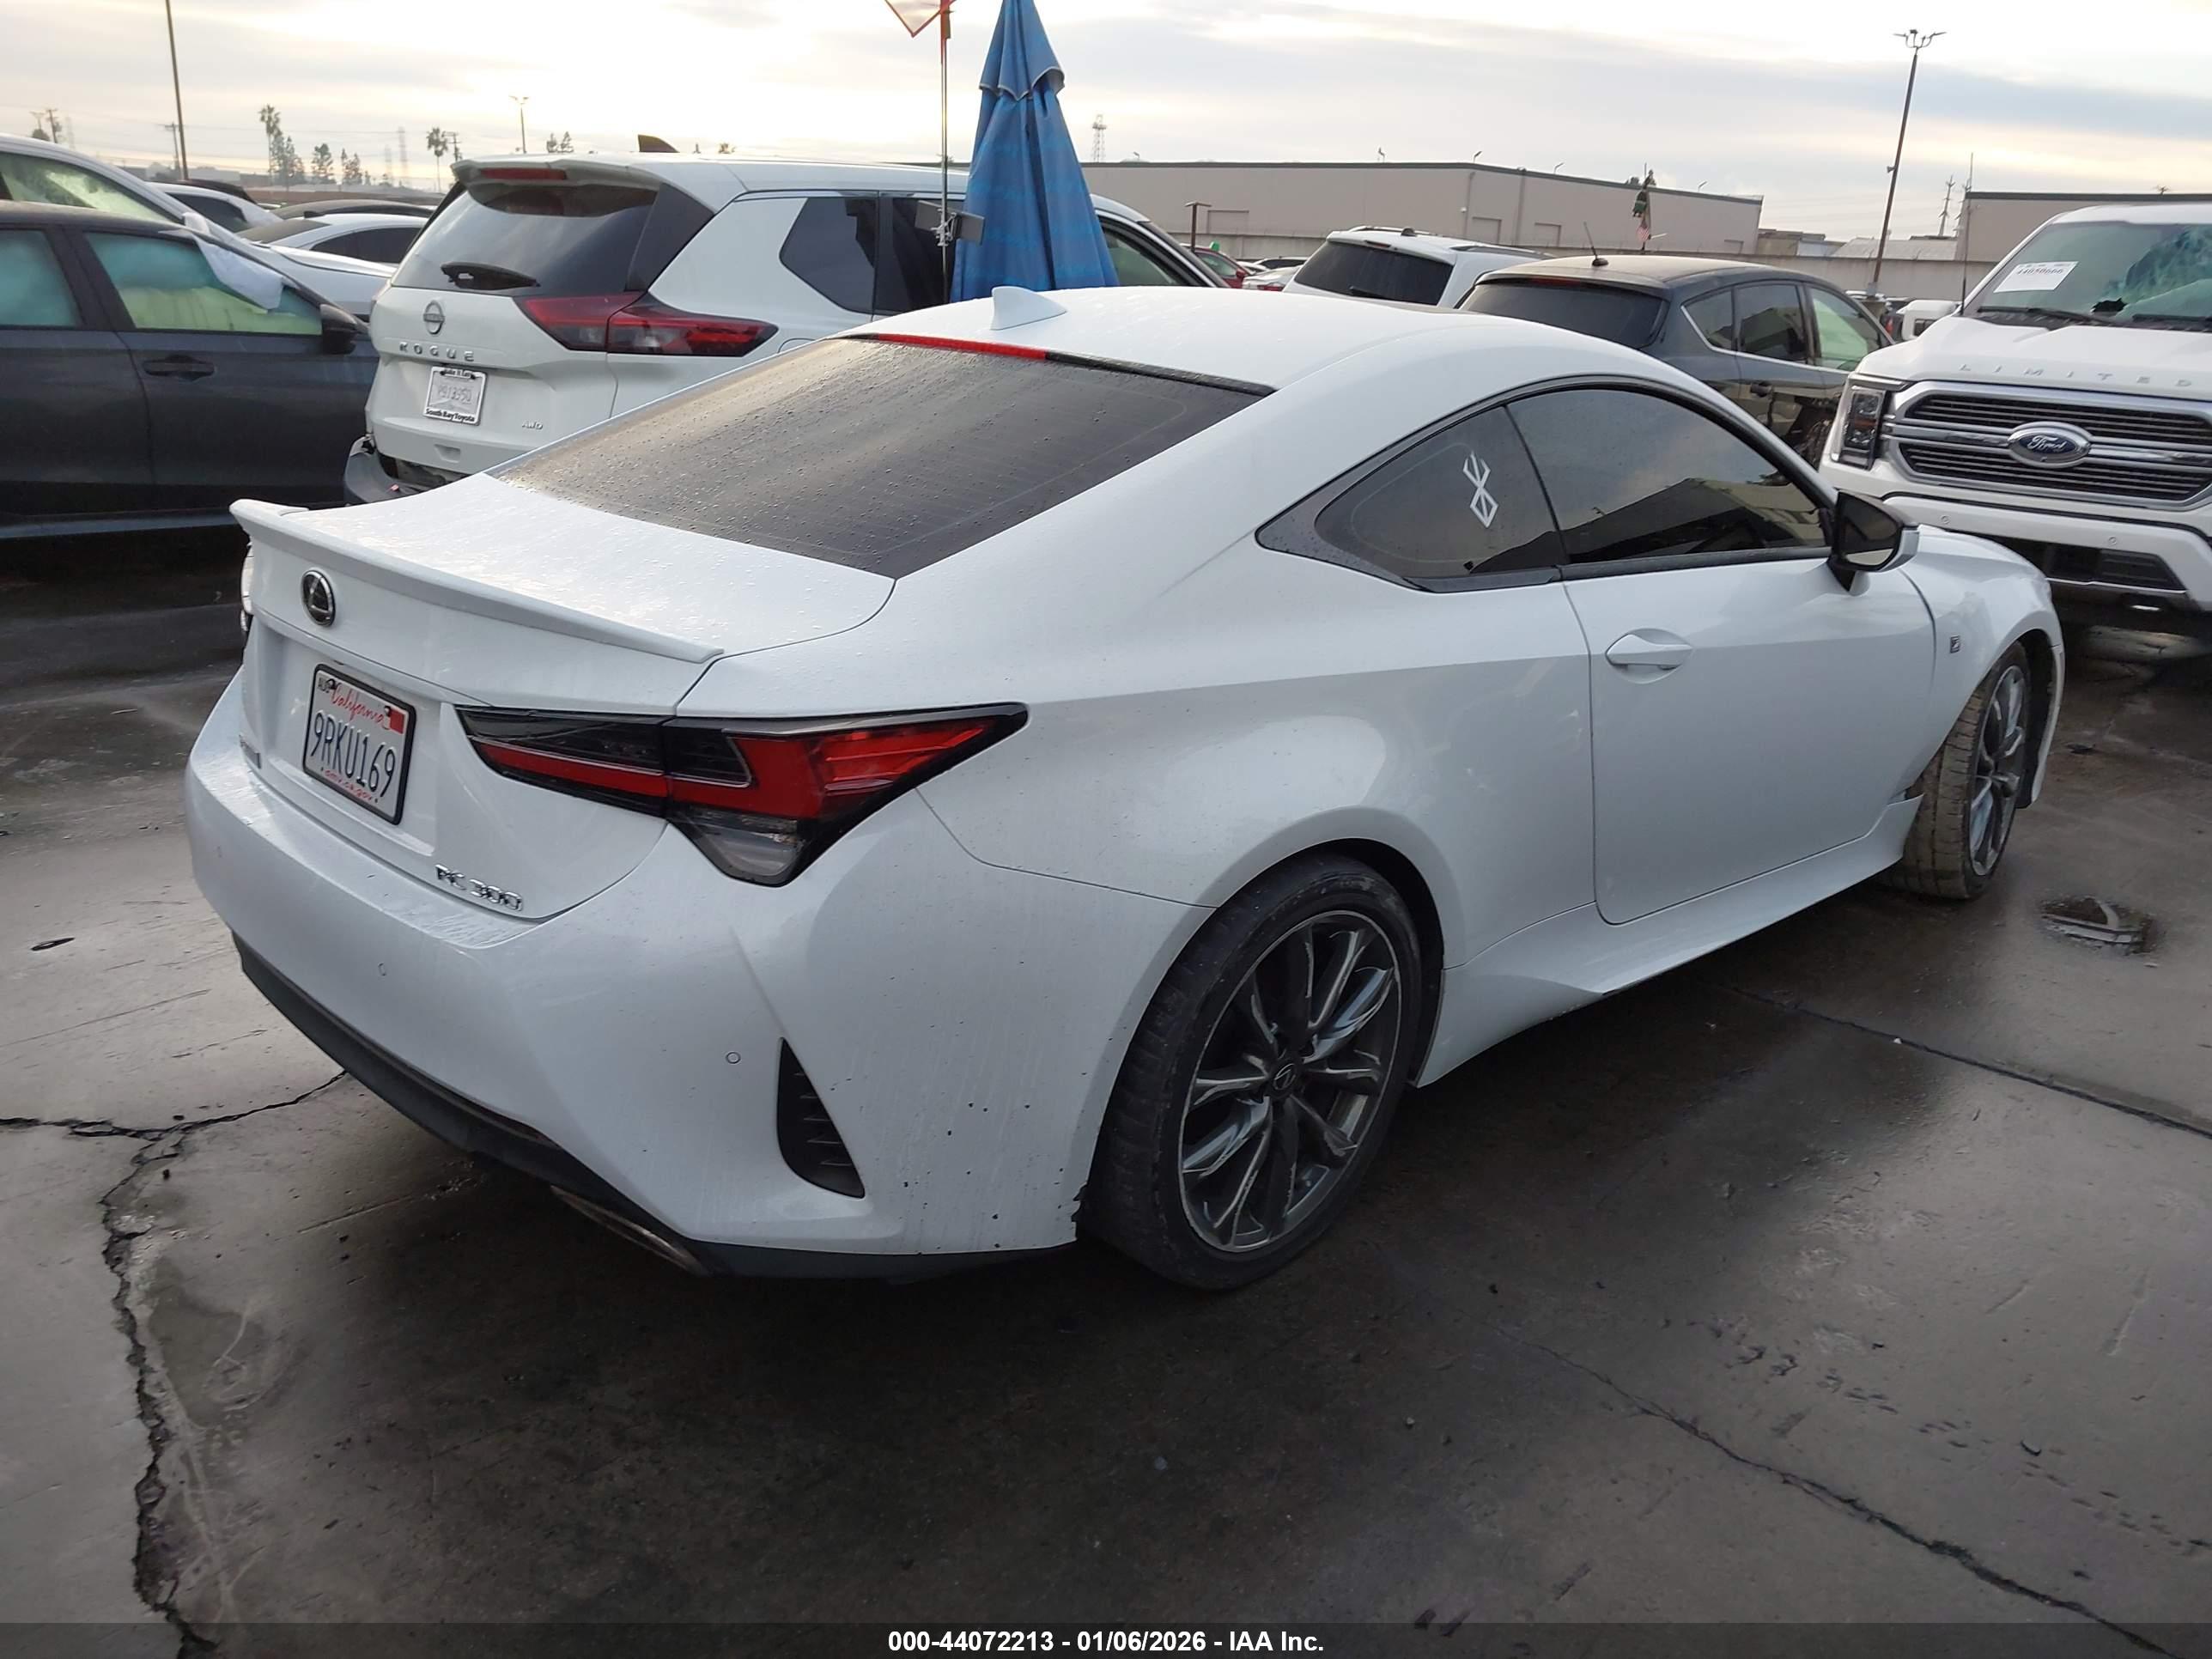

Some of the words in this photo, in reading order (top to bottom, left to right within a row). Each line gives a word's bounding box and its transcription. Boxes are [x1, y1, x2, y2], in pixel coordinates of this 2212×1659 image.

[399, 342, 475, 362] ROGUE
[1959, 363, 2192, 387] LIMITED
[426, 408, 442, 417] South
[453, 413, 475, 422] Toyota
[521, 420, 544, 430] AWD
[2026, 434, 2068, 453] Ford
[331, 683, 385, 723] California
[311, 709, 396, 798] 9RKU169
[435, 864, 466, 890] RC
[470, 878, 523, 912] 300
